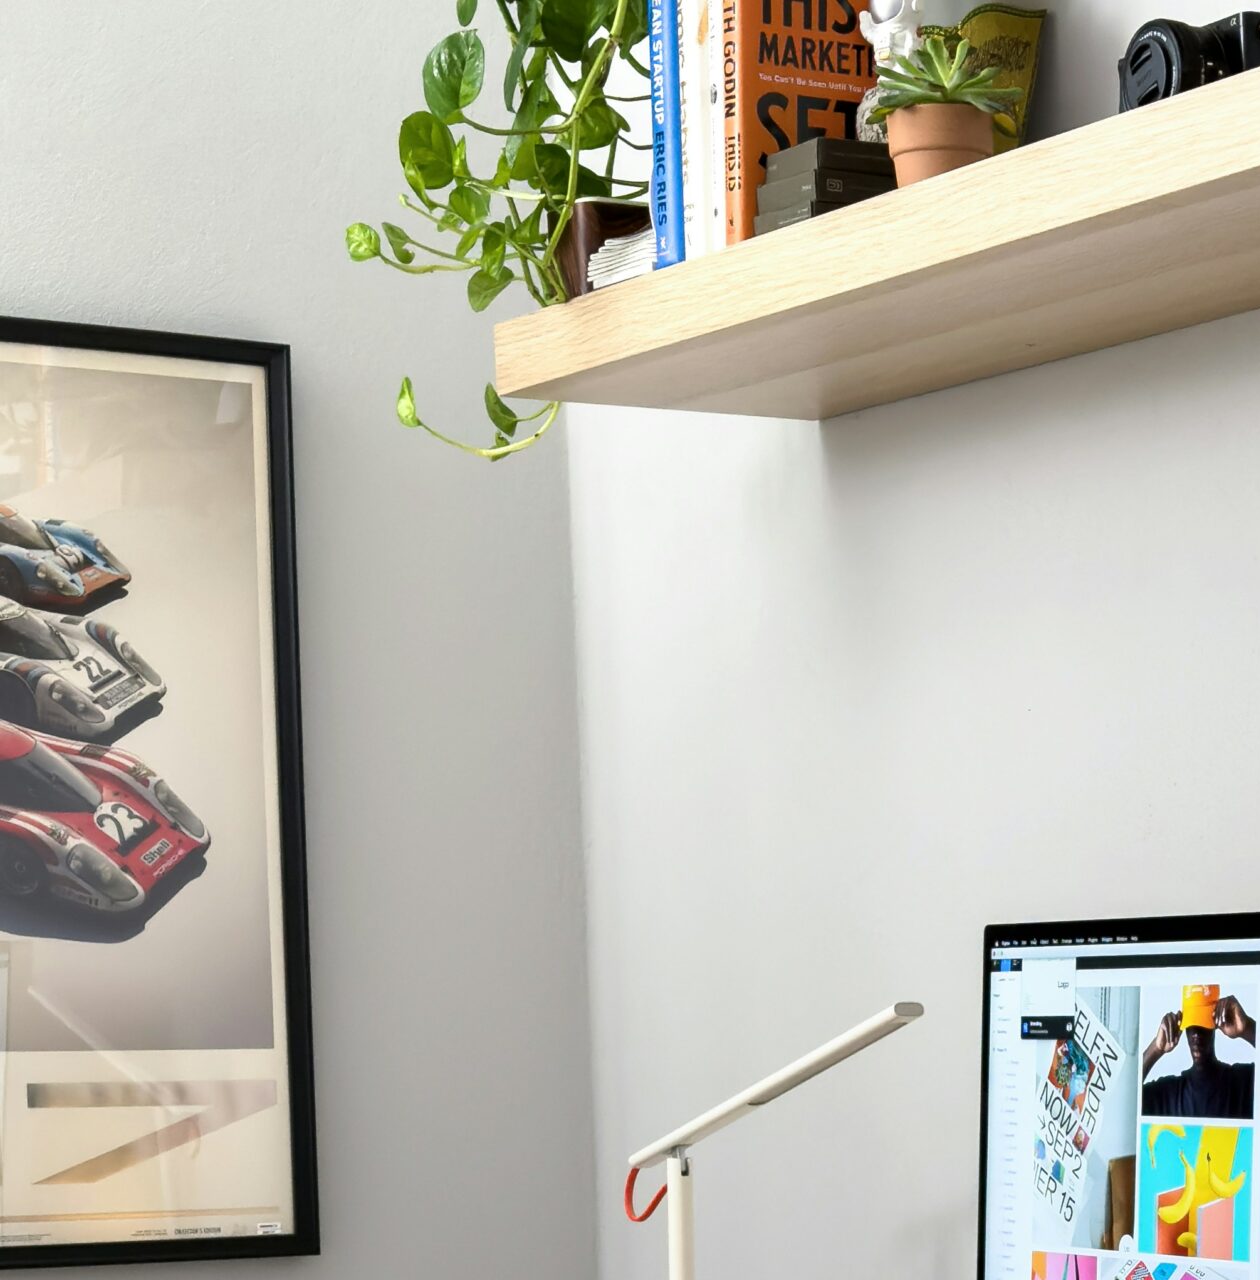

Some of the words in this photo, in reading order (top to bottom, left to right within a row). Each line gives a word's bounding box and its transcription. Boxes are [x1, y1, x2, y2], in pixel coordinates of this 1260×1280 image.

[652, 40, 664, 124] STARTUP
[723, 41, 736, 119] GODIN
[656, 131, 666, 177] ERIC
[657, 181, 668, 226] RIES
[73, 656, 112, 682] 22
[96, 803, 150, 846] 23
[143, 840, 170, 864] Shell
[1040, 1081, 1078, 1136] NOW
[1046, 1121, 1074, 1160] SEP
[1072, 1154, 1083, 1179] 2
[1059, 1192, 1076, 1223] 15
